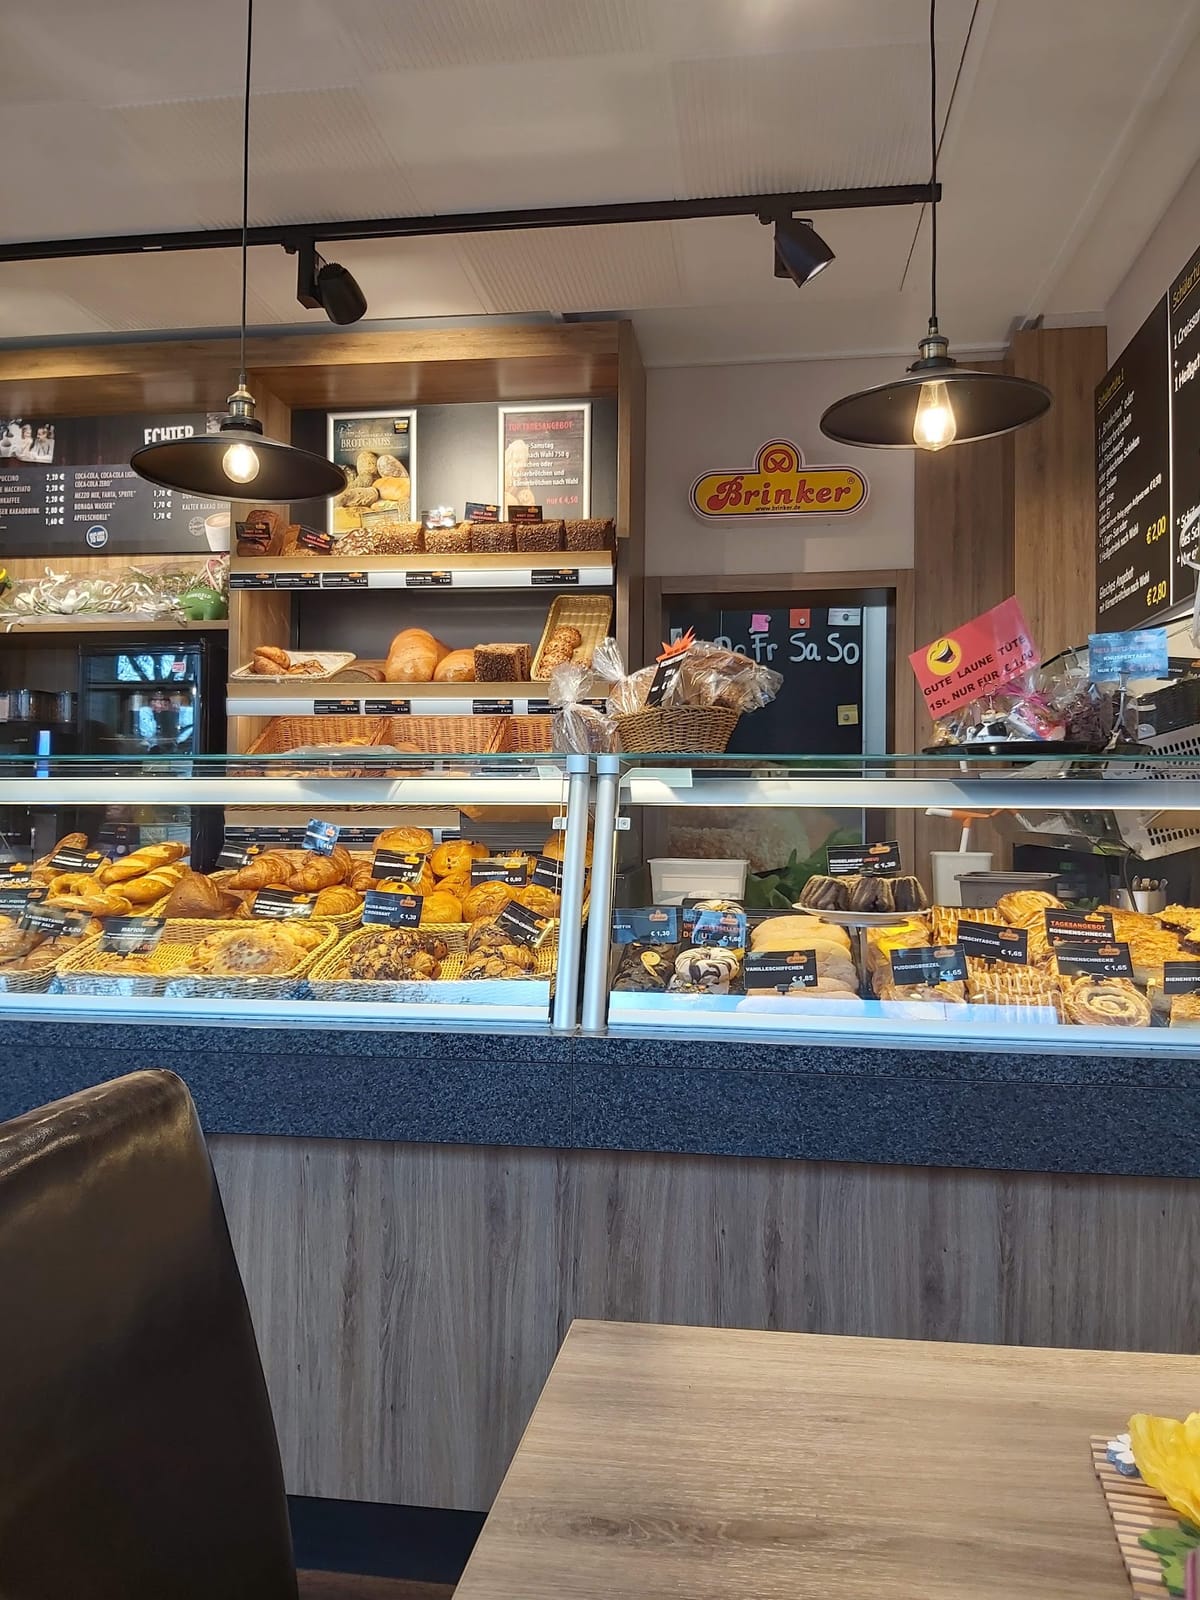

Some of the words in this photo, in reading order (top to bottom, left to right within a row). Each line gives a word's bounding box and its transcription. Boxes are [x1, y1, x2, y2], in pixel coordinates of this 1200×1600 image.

[341, 437, 391, 448] BROTGENUSS
[707, 476, 852, 511] Brinker
[750, 633, 778, 663] Fr
[789, 632, 821, 662] Sa
[826, 632, 860, 665] So
[923, 675, 953, 697] GUTE
[957, 653, 994, 679] LAUNE
[997, 634, 1026, 657] TÜTE
[929, 697, 951, 711] 1St.
[952, 682, 976, 701] NUR
[978, 670, 1001, 688] FÜR
[1050, 920, 1106, 930] TAGESANGEBOT
[1049, 927, 1113, 938] ROSINENSCHNECKE
[958, 935, 1001, 946] KIRSCHTASCHE
[1057, 955, 1115, 963] ROSINENSCHNECKE
[893, 962, 941, 971] PUDDINGBREZEL
